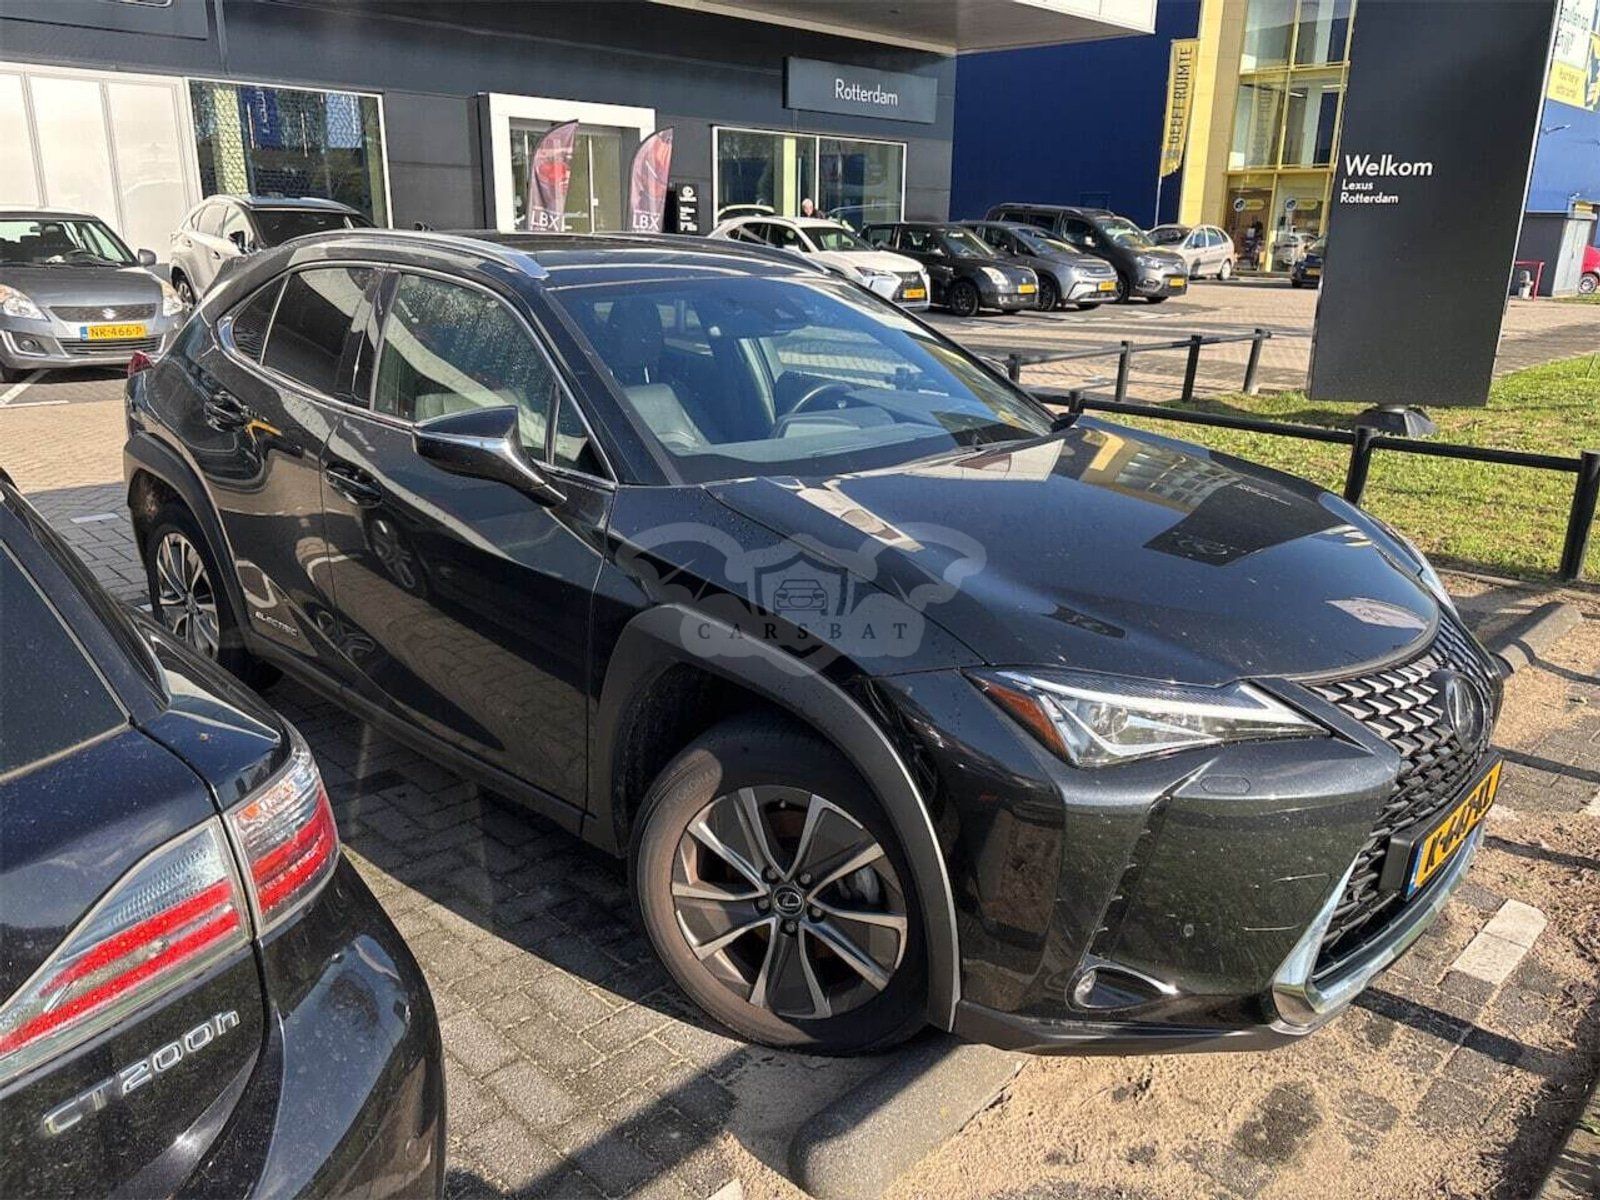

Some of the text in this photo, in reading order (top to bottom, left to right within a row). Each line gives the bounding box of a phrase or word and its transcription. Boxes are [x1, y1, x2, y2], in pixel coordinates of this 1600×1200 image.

[1173, 47, 1193, 99] RUIMTE
[834, 78, 899, 106] Rotterdam
[1344, 153, 1434, 177] Welkom
[1341, 178, 1374, 191] Lexus
[1339, 192, 1400, 204] Rotterdam
[530, 210, 560, 232] LBX
[632, 211, 661, 231] LBX
